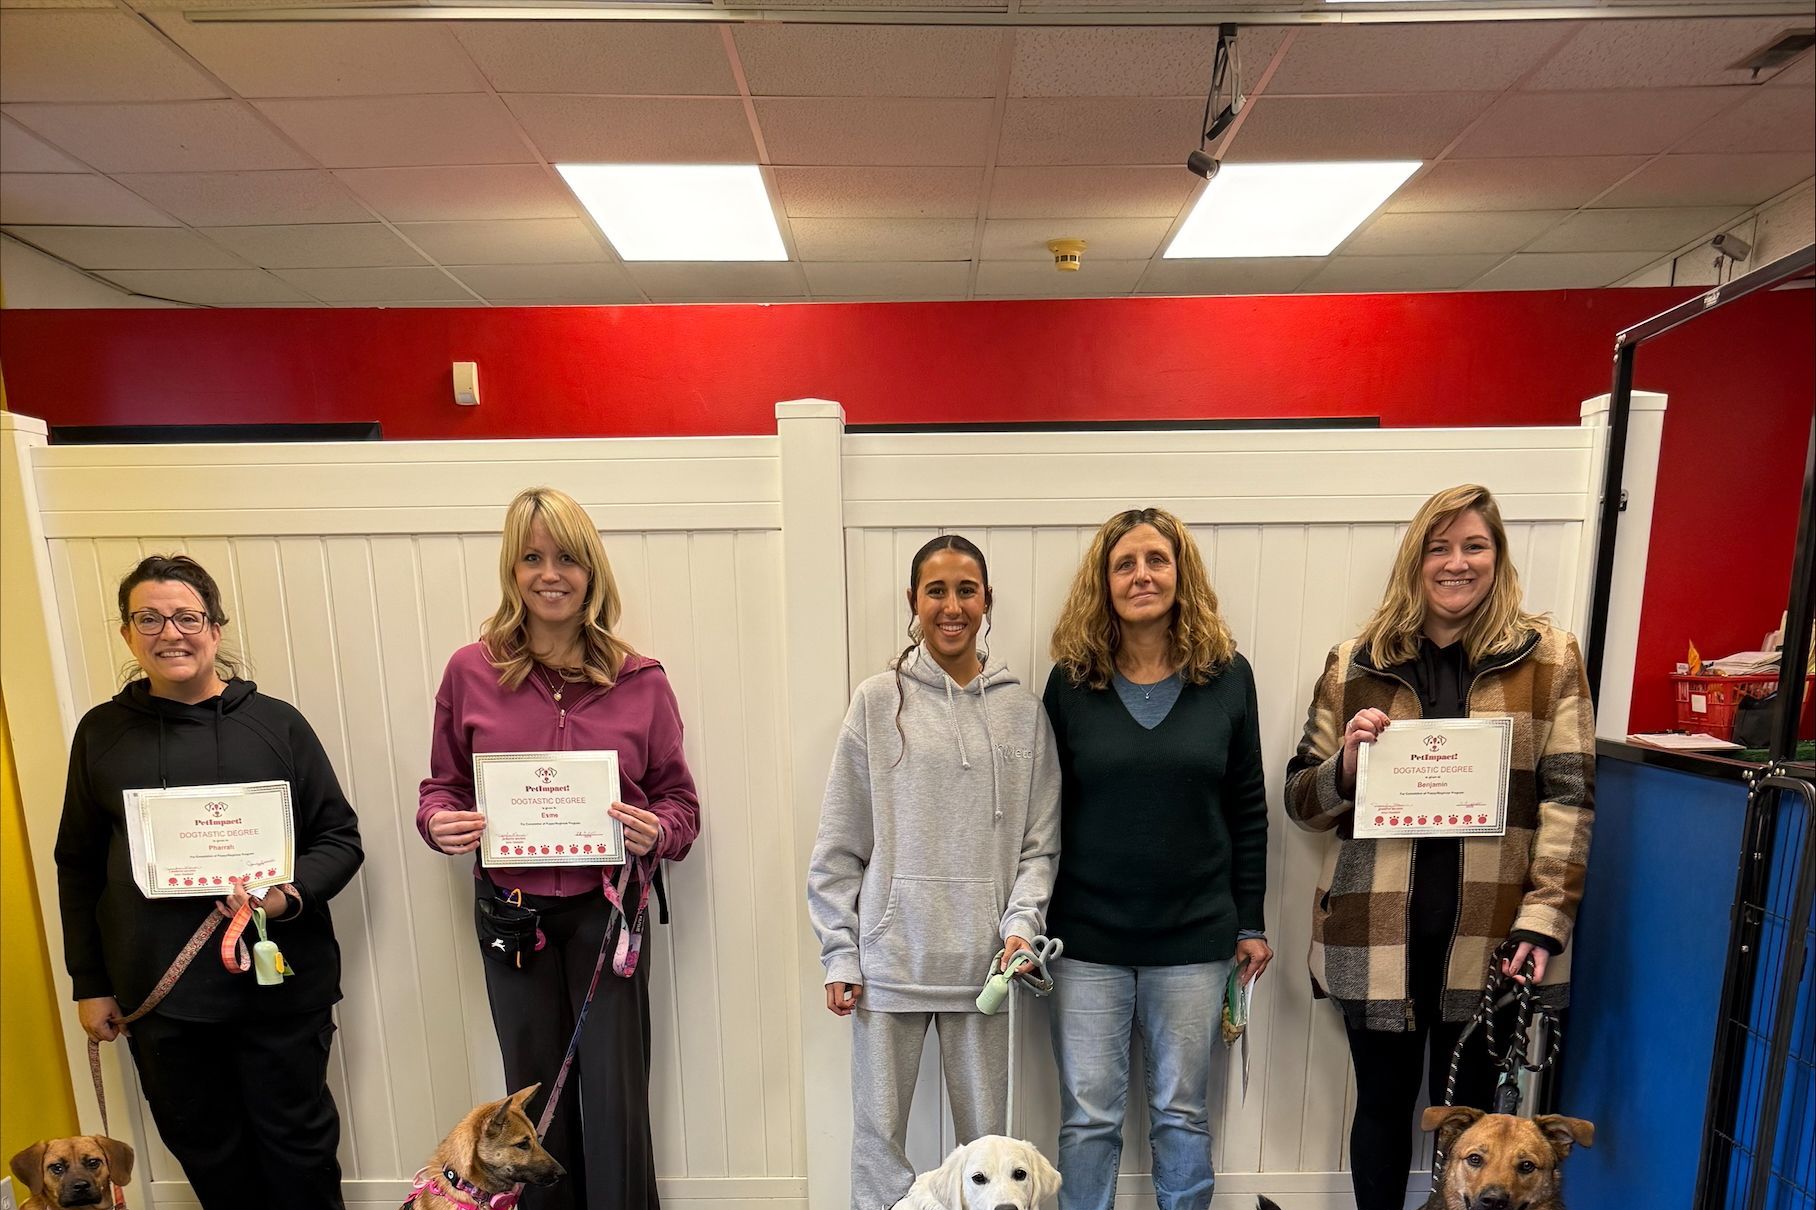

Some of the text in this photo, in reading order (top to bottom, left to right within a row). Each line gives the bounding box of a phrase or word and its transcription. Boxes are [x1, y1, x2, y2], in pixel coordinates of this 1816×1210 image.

[1410, 753, 1458, 762] PetImpact!
[1393, 765, 1473, 774] DOGTASTIC DEGREE
[525, 785, 570, 793] PetImpact!
[1417, 781, 1448, 789] Benjamin
[511, 797, 554, 805] DOGTASTIC
[195, 817, 242, 826] PetImpact!
[179, 828, 259, 839] DOGTASTIC DEGREE
